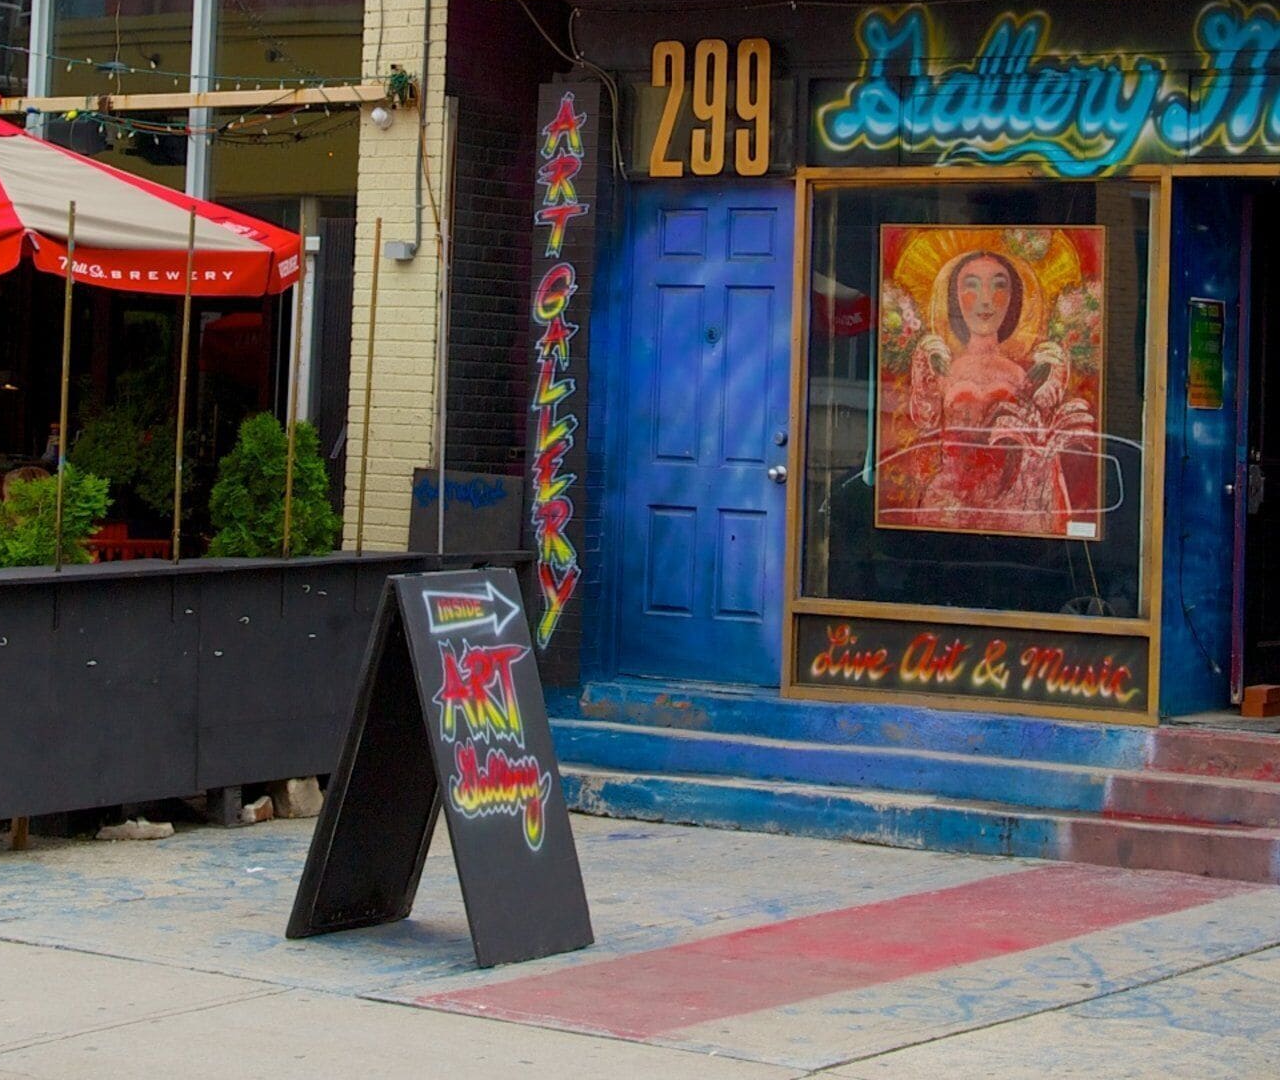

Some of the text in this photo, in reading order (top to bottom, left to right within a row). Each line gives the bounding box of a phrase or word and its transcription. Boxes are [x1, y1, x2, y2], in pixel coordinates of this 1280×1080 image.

[649, 37, 772, 178] 299
[817, 2, 1166, 179] Gallery
[111, 270, 234, 281] BREWERY
[531, 90, 590, 649] ART GALLERY
[436, 597, 486, 622] INSIDE
[811, 621, 1140, 702] Live Art & Music
[432, 638, 532, 749] ART
